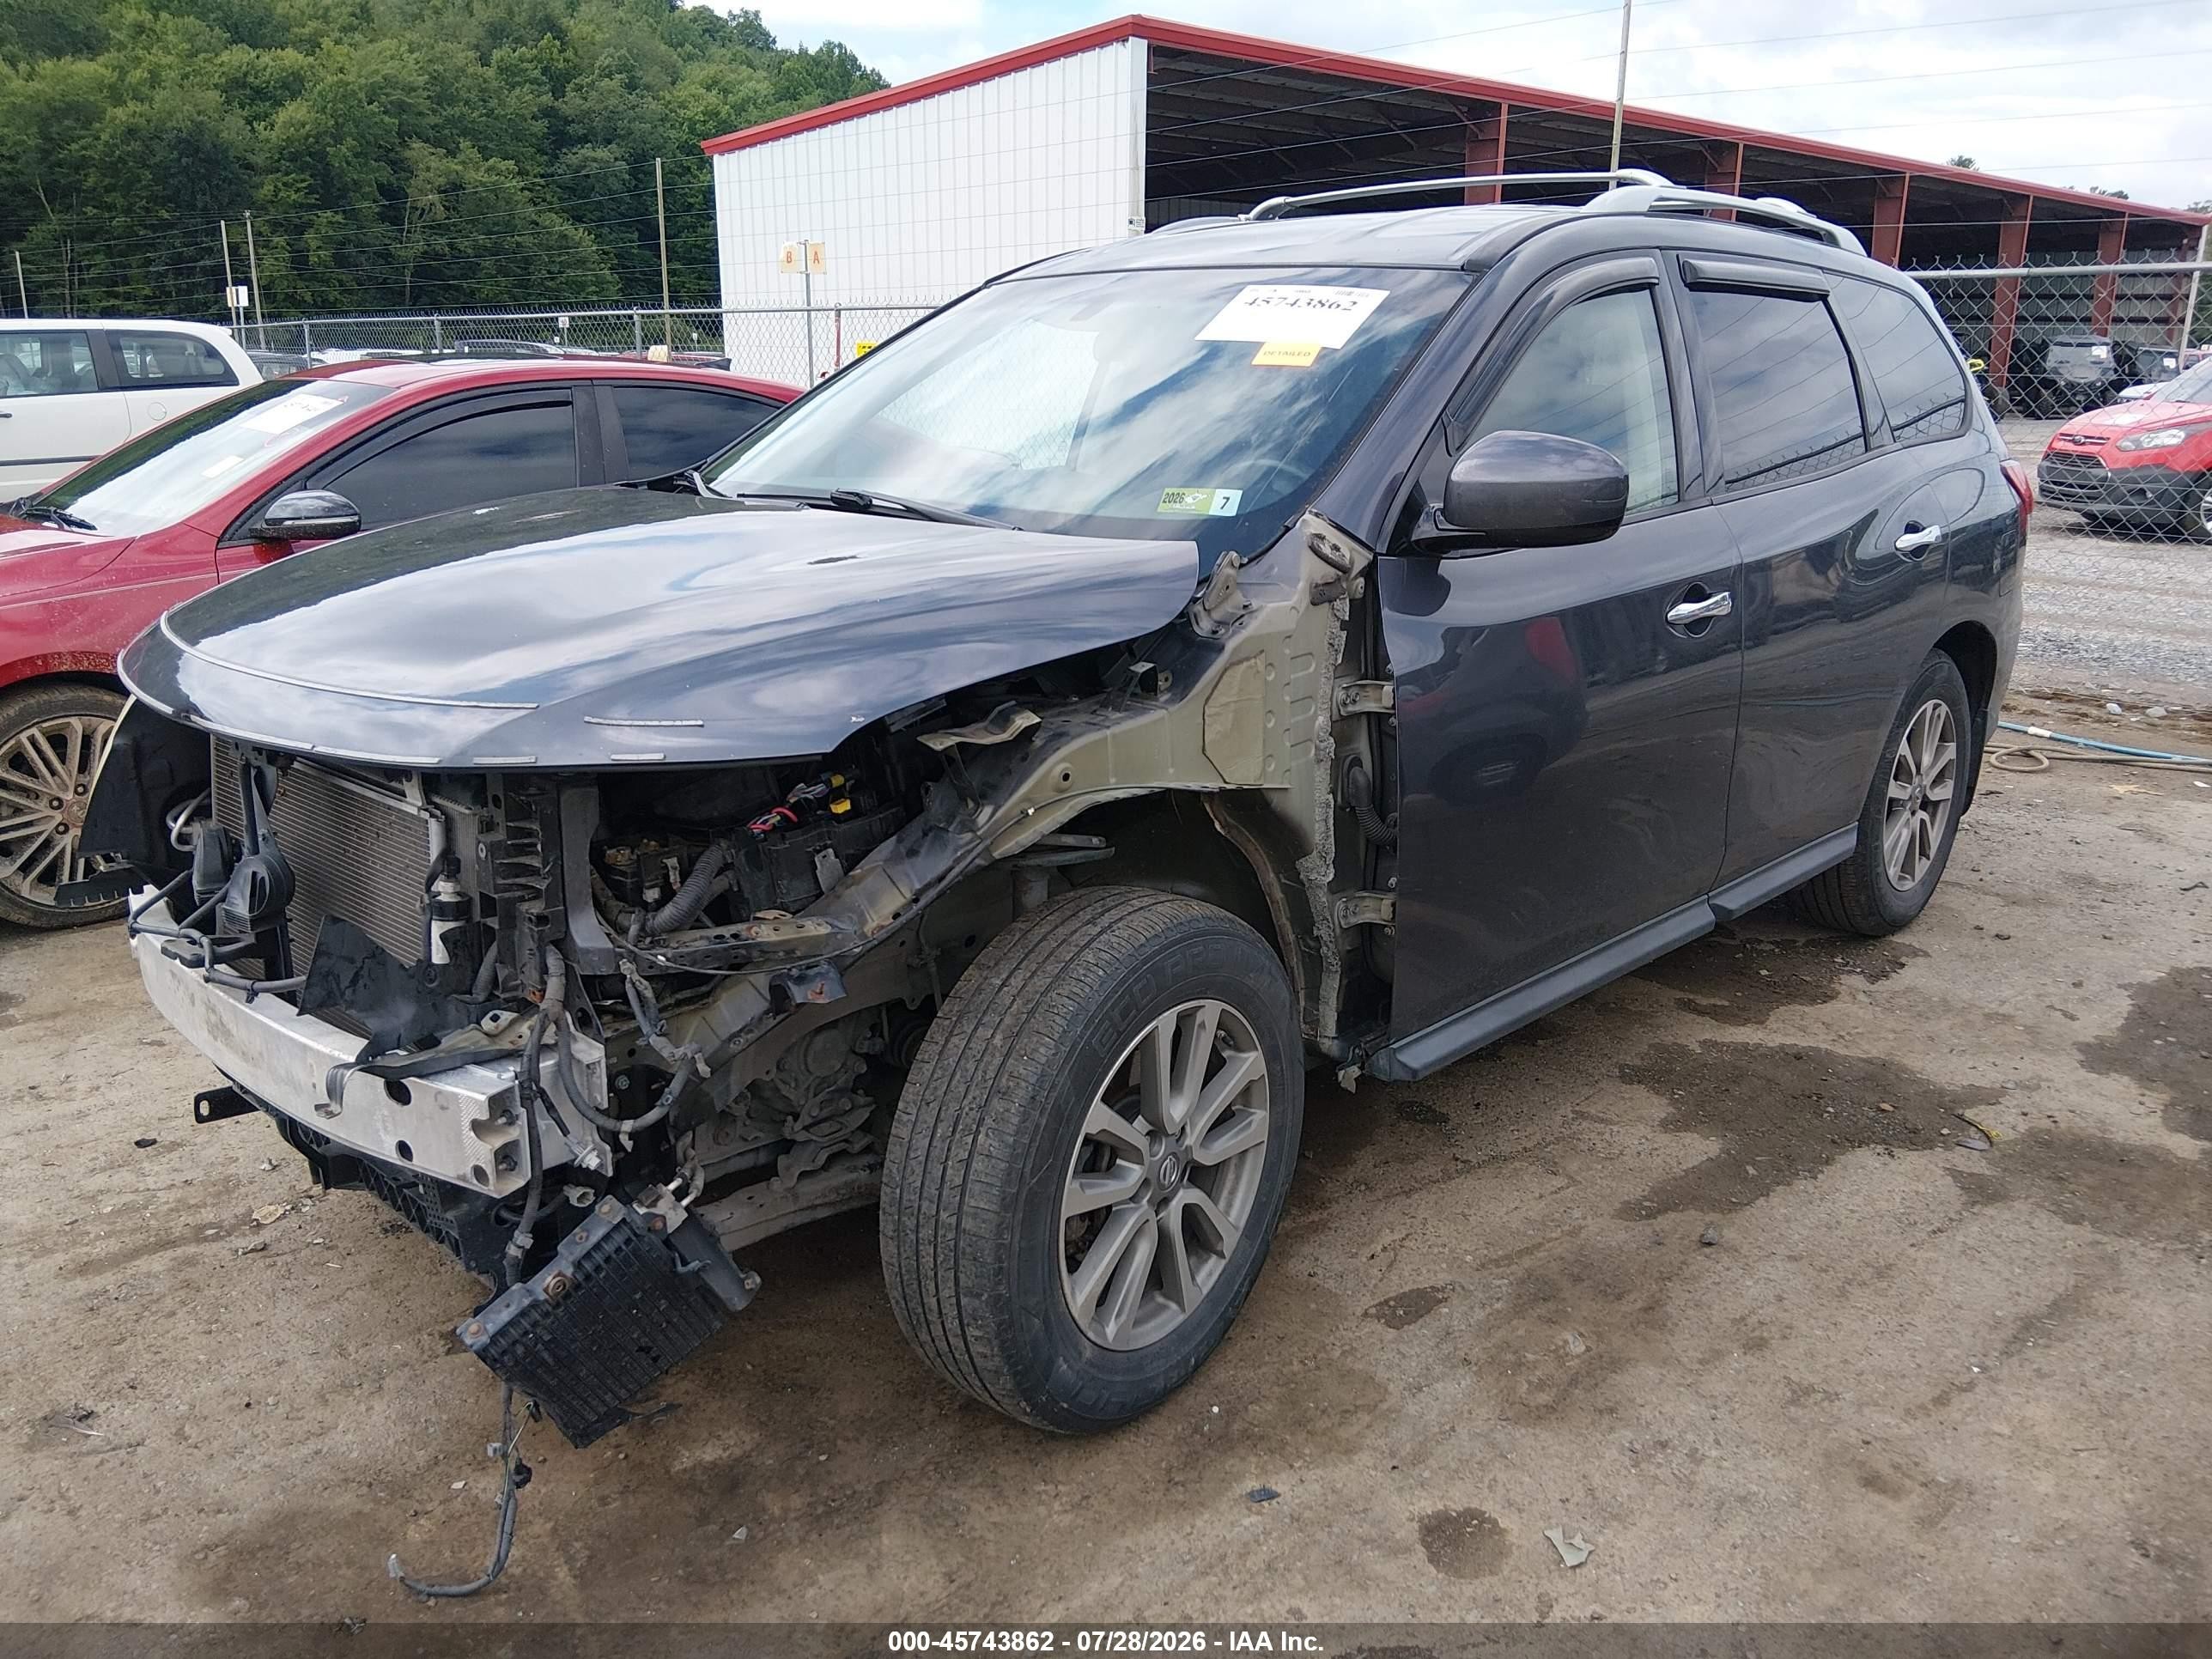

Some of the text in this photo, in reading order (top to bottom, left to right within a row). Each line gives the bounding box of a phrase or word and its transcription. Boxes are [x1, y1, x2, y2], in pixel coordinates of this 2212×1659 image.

[786, 251, 793, 264] B
[812, 251, 820, 264] A
[1244, 296, 1358, 312] 45743862
[1162, 492, 1186, 504] 2026
[1219, 496, 1231, 510] 7
